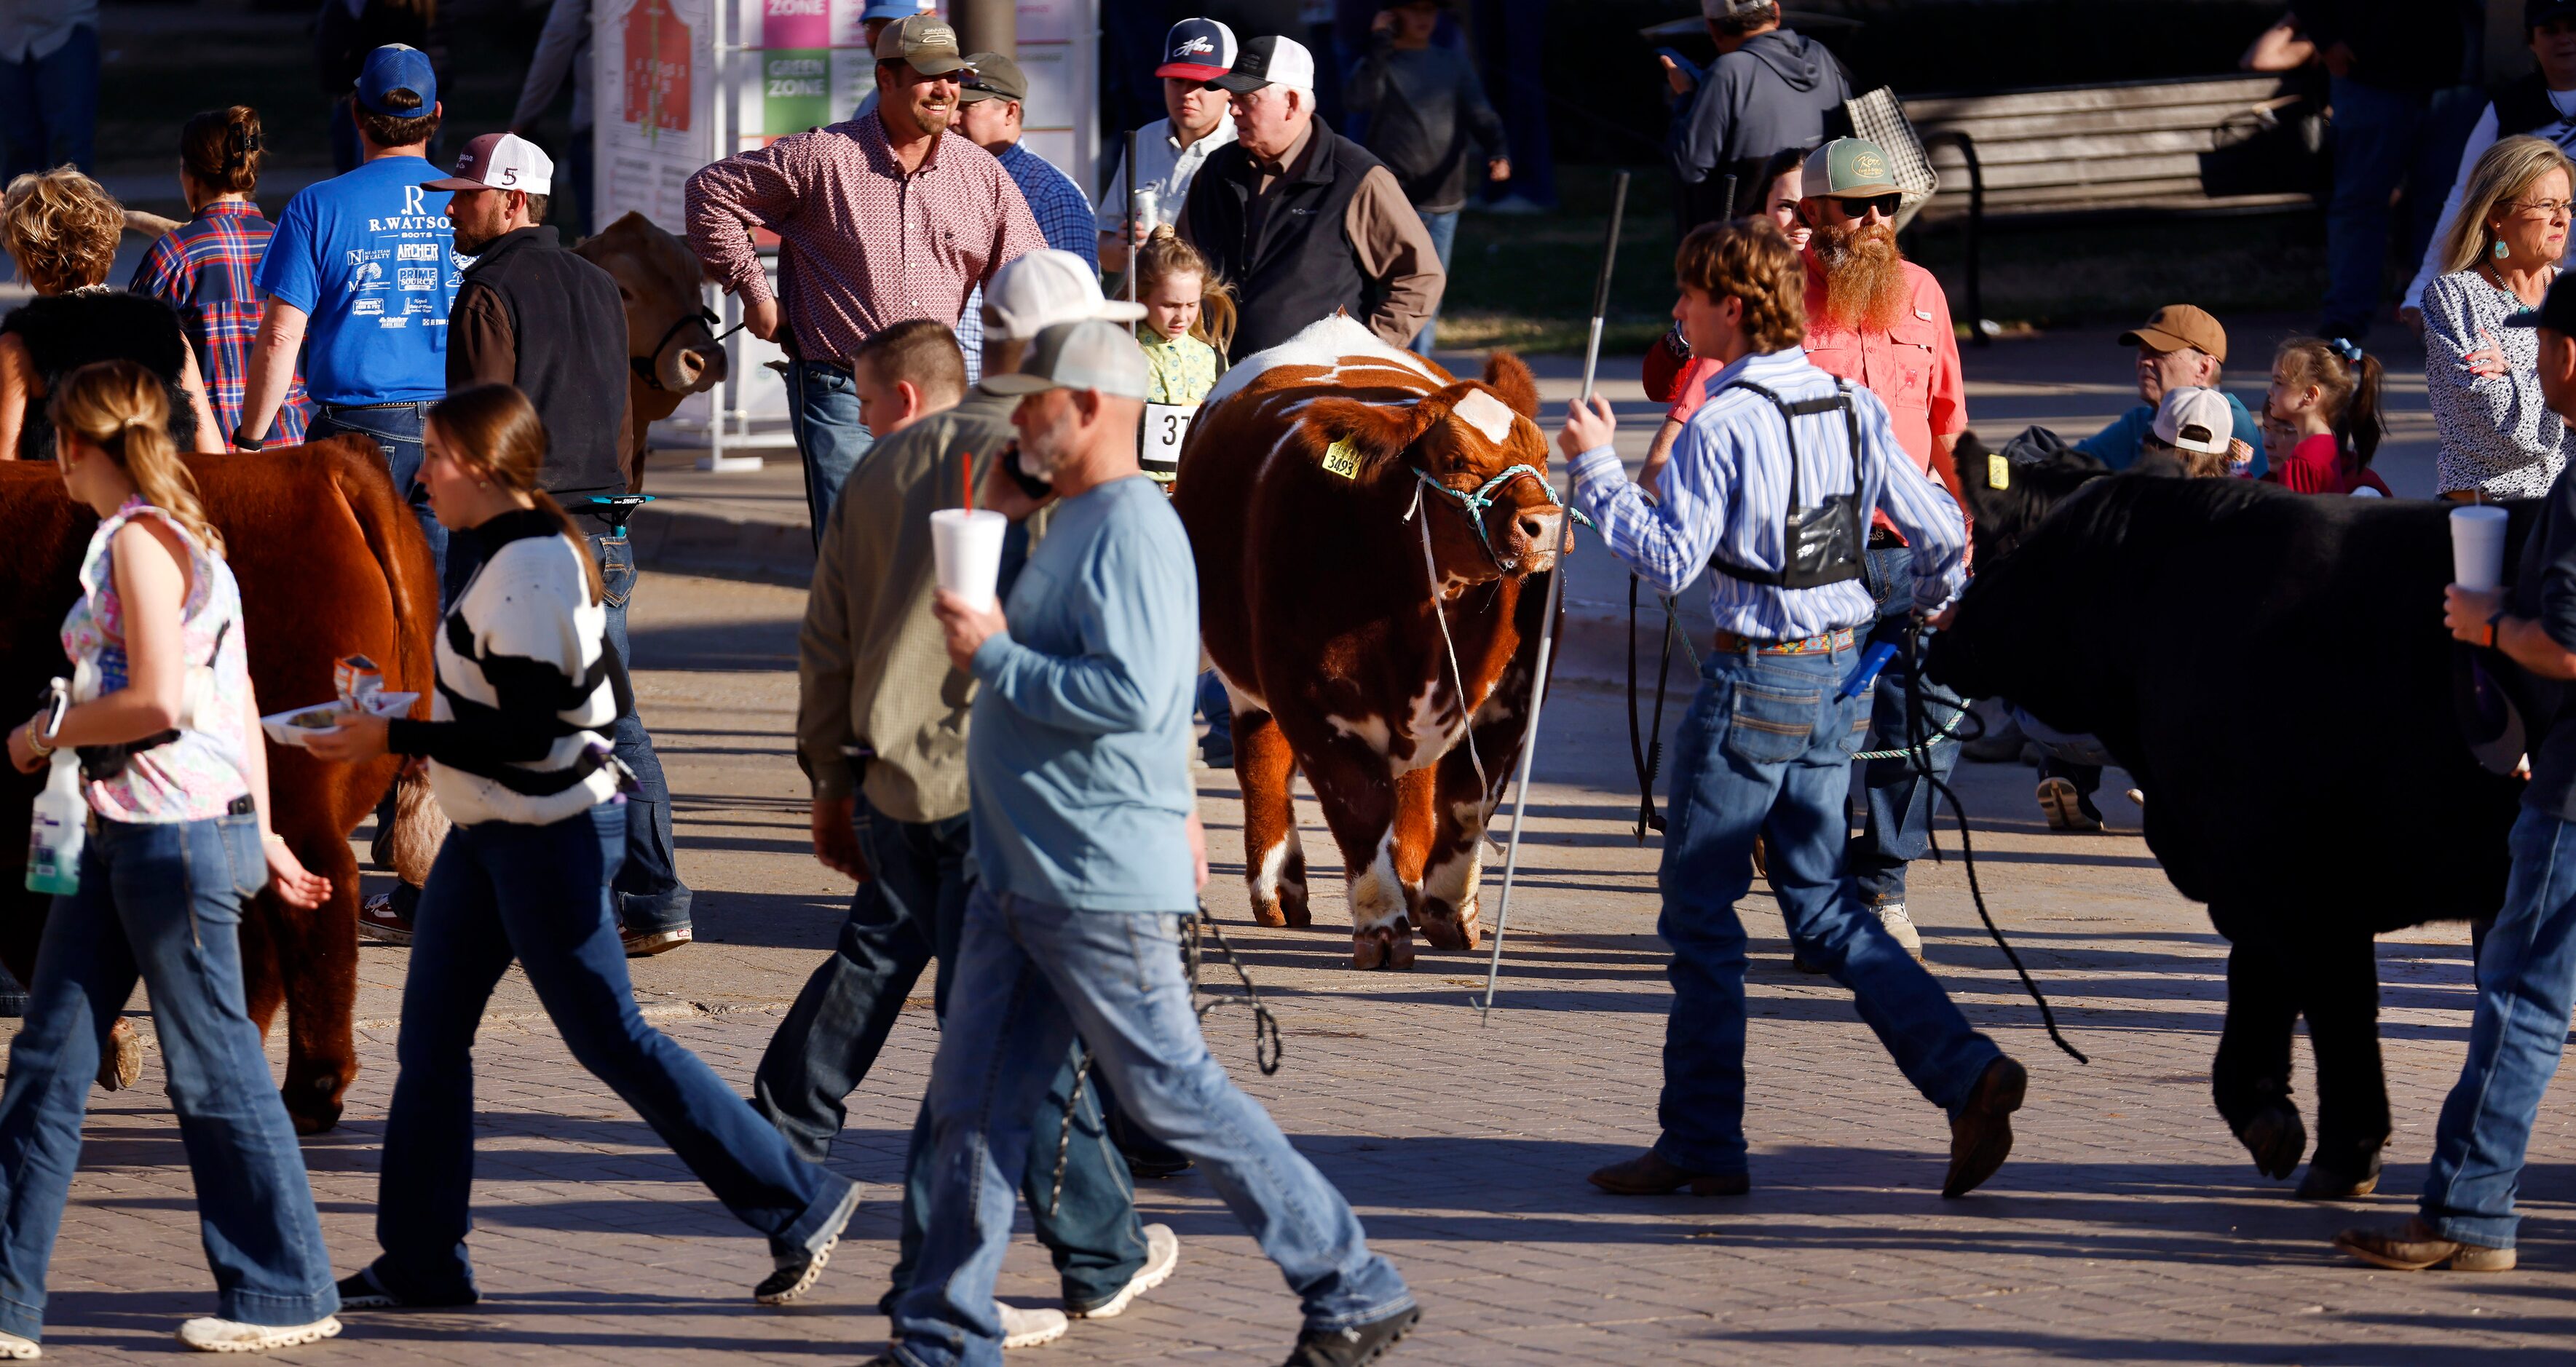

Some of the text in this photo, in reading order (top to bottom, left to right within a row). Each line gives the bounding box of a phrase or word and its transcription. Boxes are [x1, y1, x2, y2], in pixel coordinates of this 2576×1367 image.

[768, 59, 826, 76] GREEN
[768, 79, 826, 97] ZONE
[369, 216, 456, 232] R.WATSO
[365, 253, 390, 261] REALTY
[398, 244, 438, 258] ARCHER
[400, 269, 436, 280] PRIME
[401, 277, 435, 285] SOURCE
[1328, 455, 1354, 475] 3493
